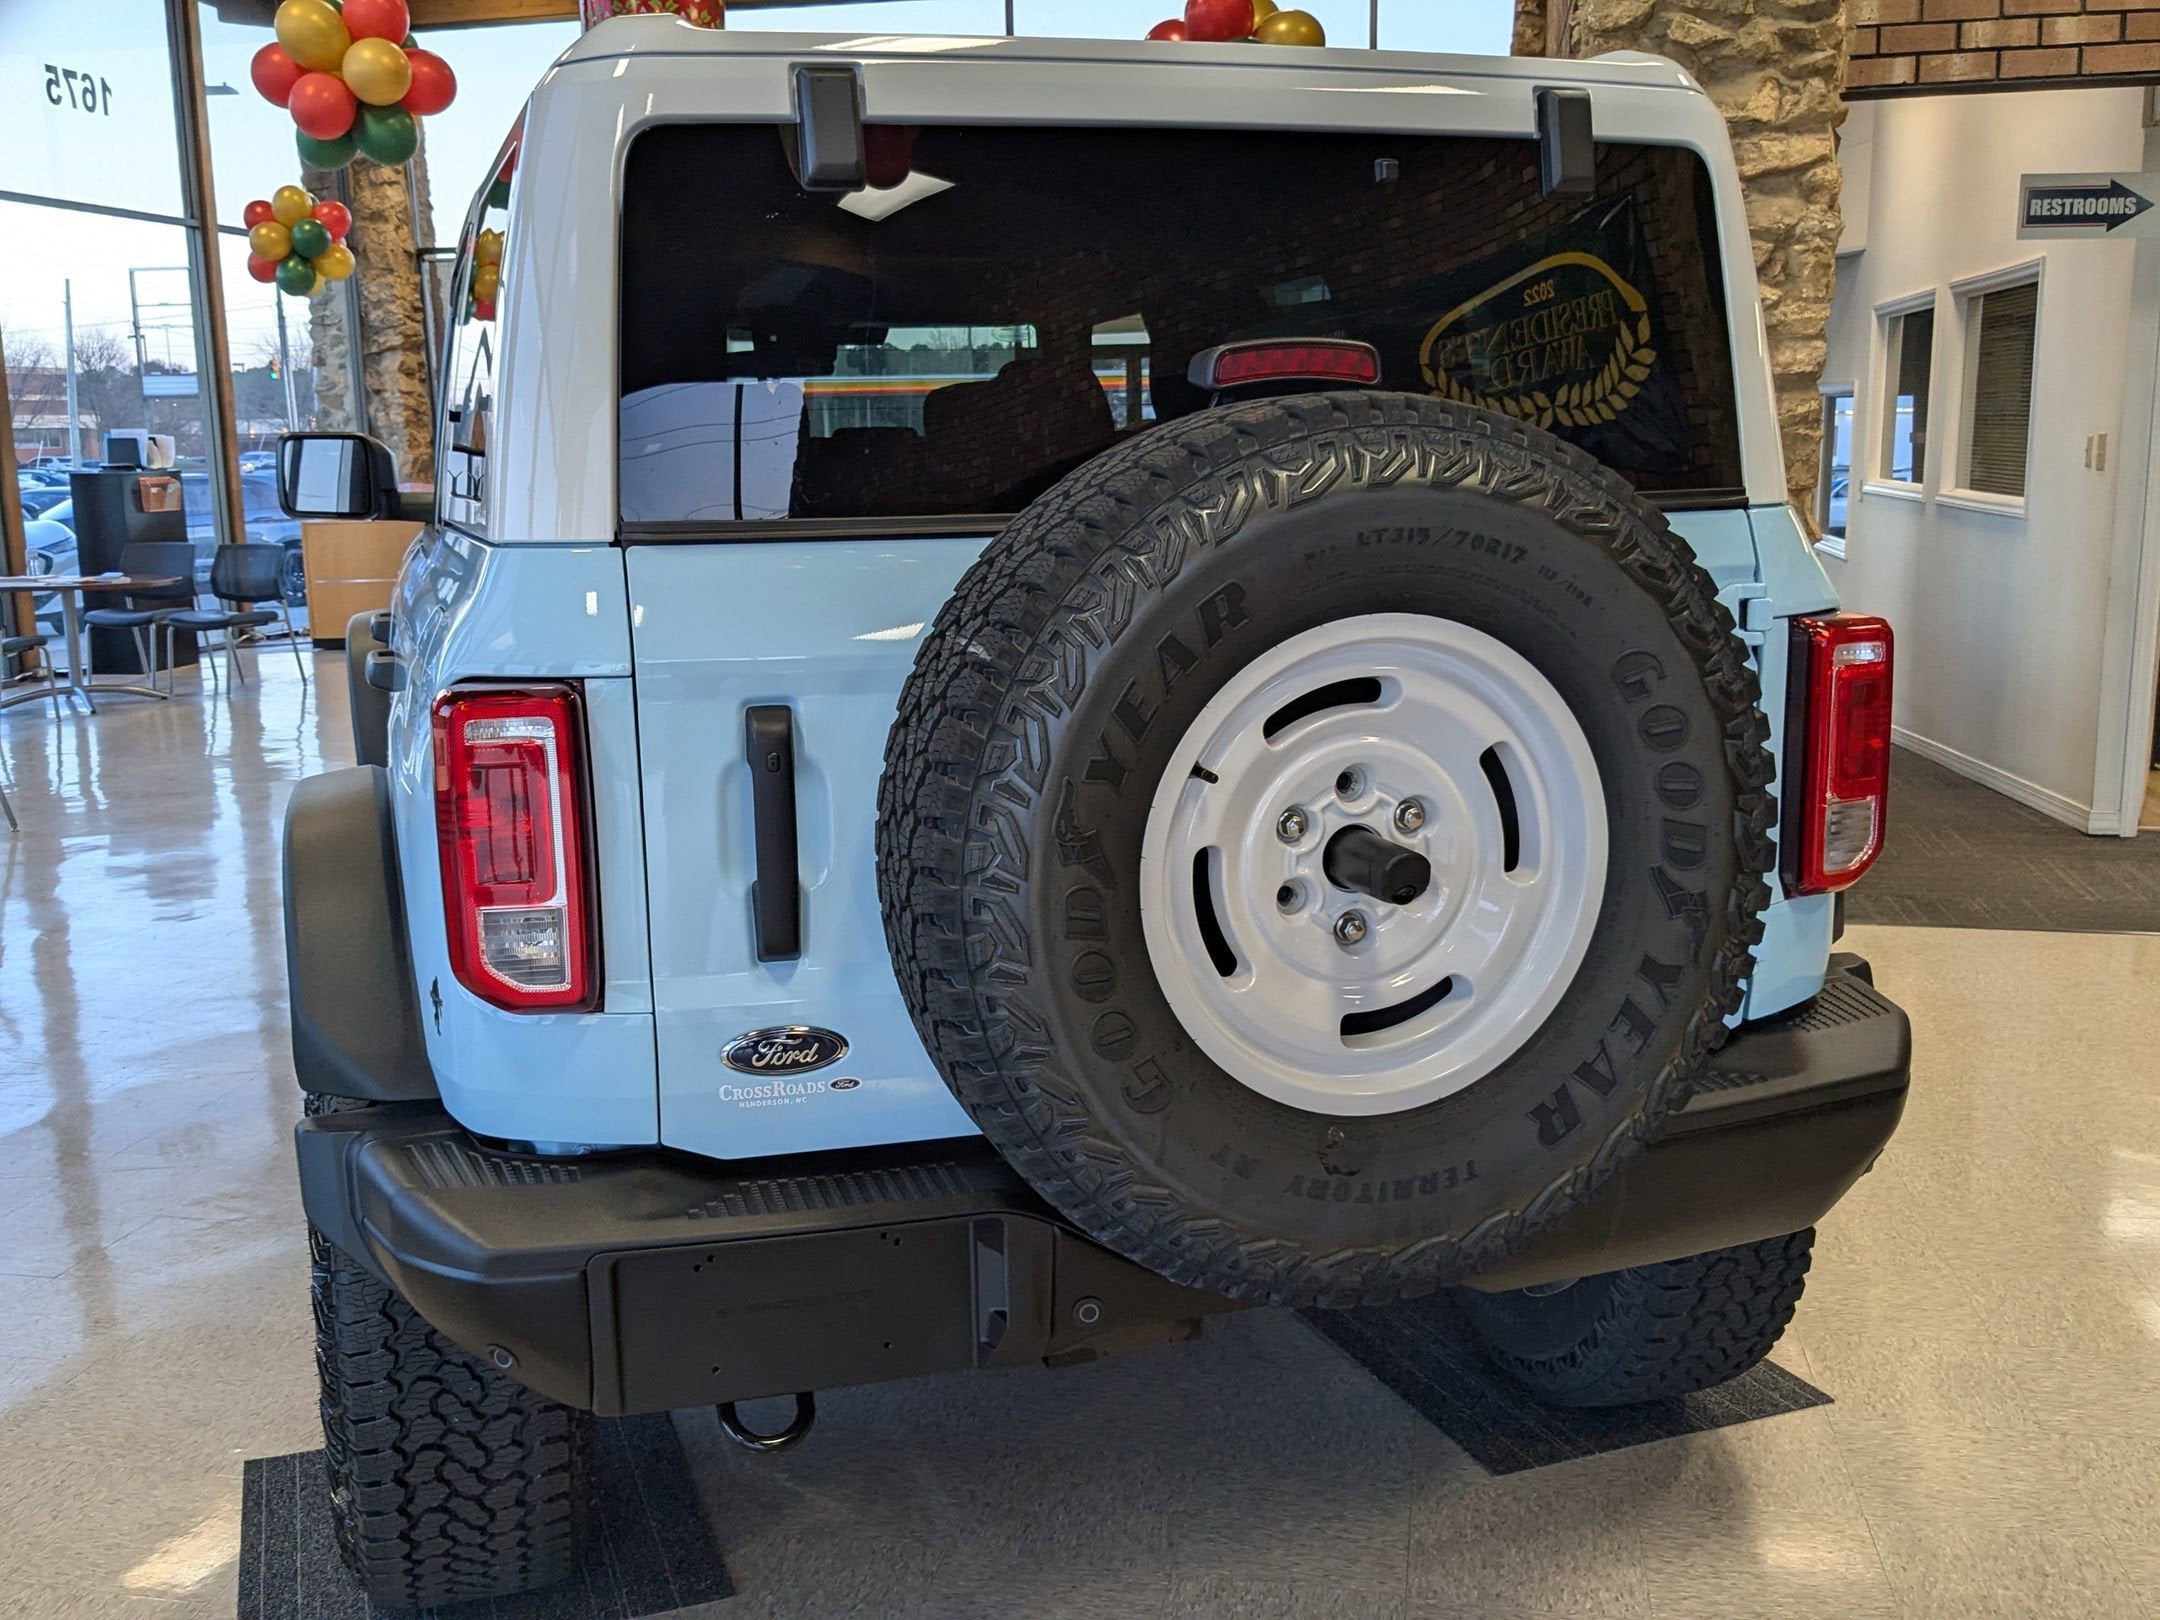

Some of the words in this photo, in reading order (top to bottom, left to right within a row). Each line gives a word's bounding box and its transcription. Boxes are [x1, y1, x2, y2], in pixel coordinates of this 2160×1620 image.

[2029, 197, 2137, 216] RESTROOMS
[751, 1037, 820, 1068] Ford
[795, 1096, 808, 1104] NC
[1281, 1159, 1480, 1203] TERRITORY
